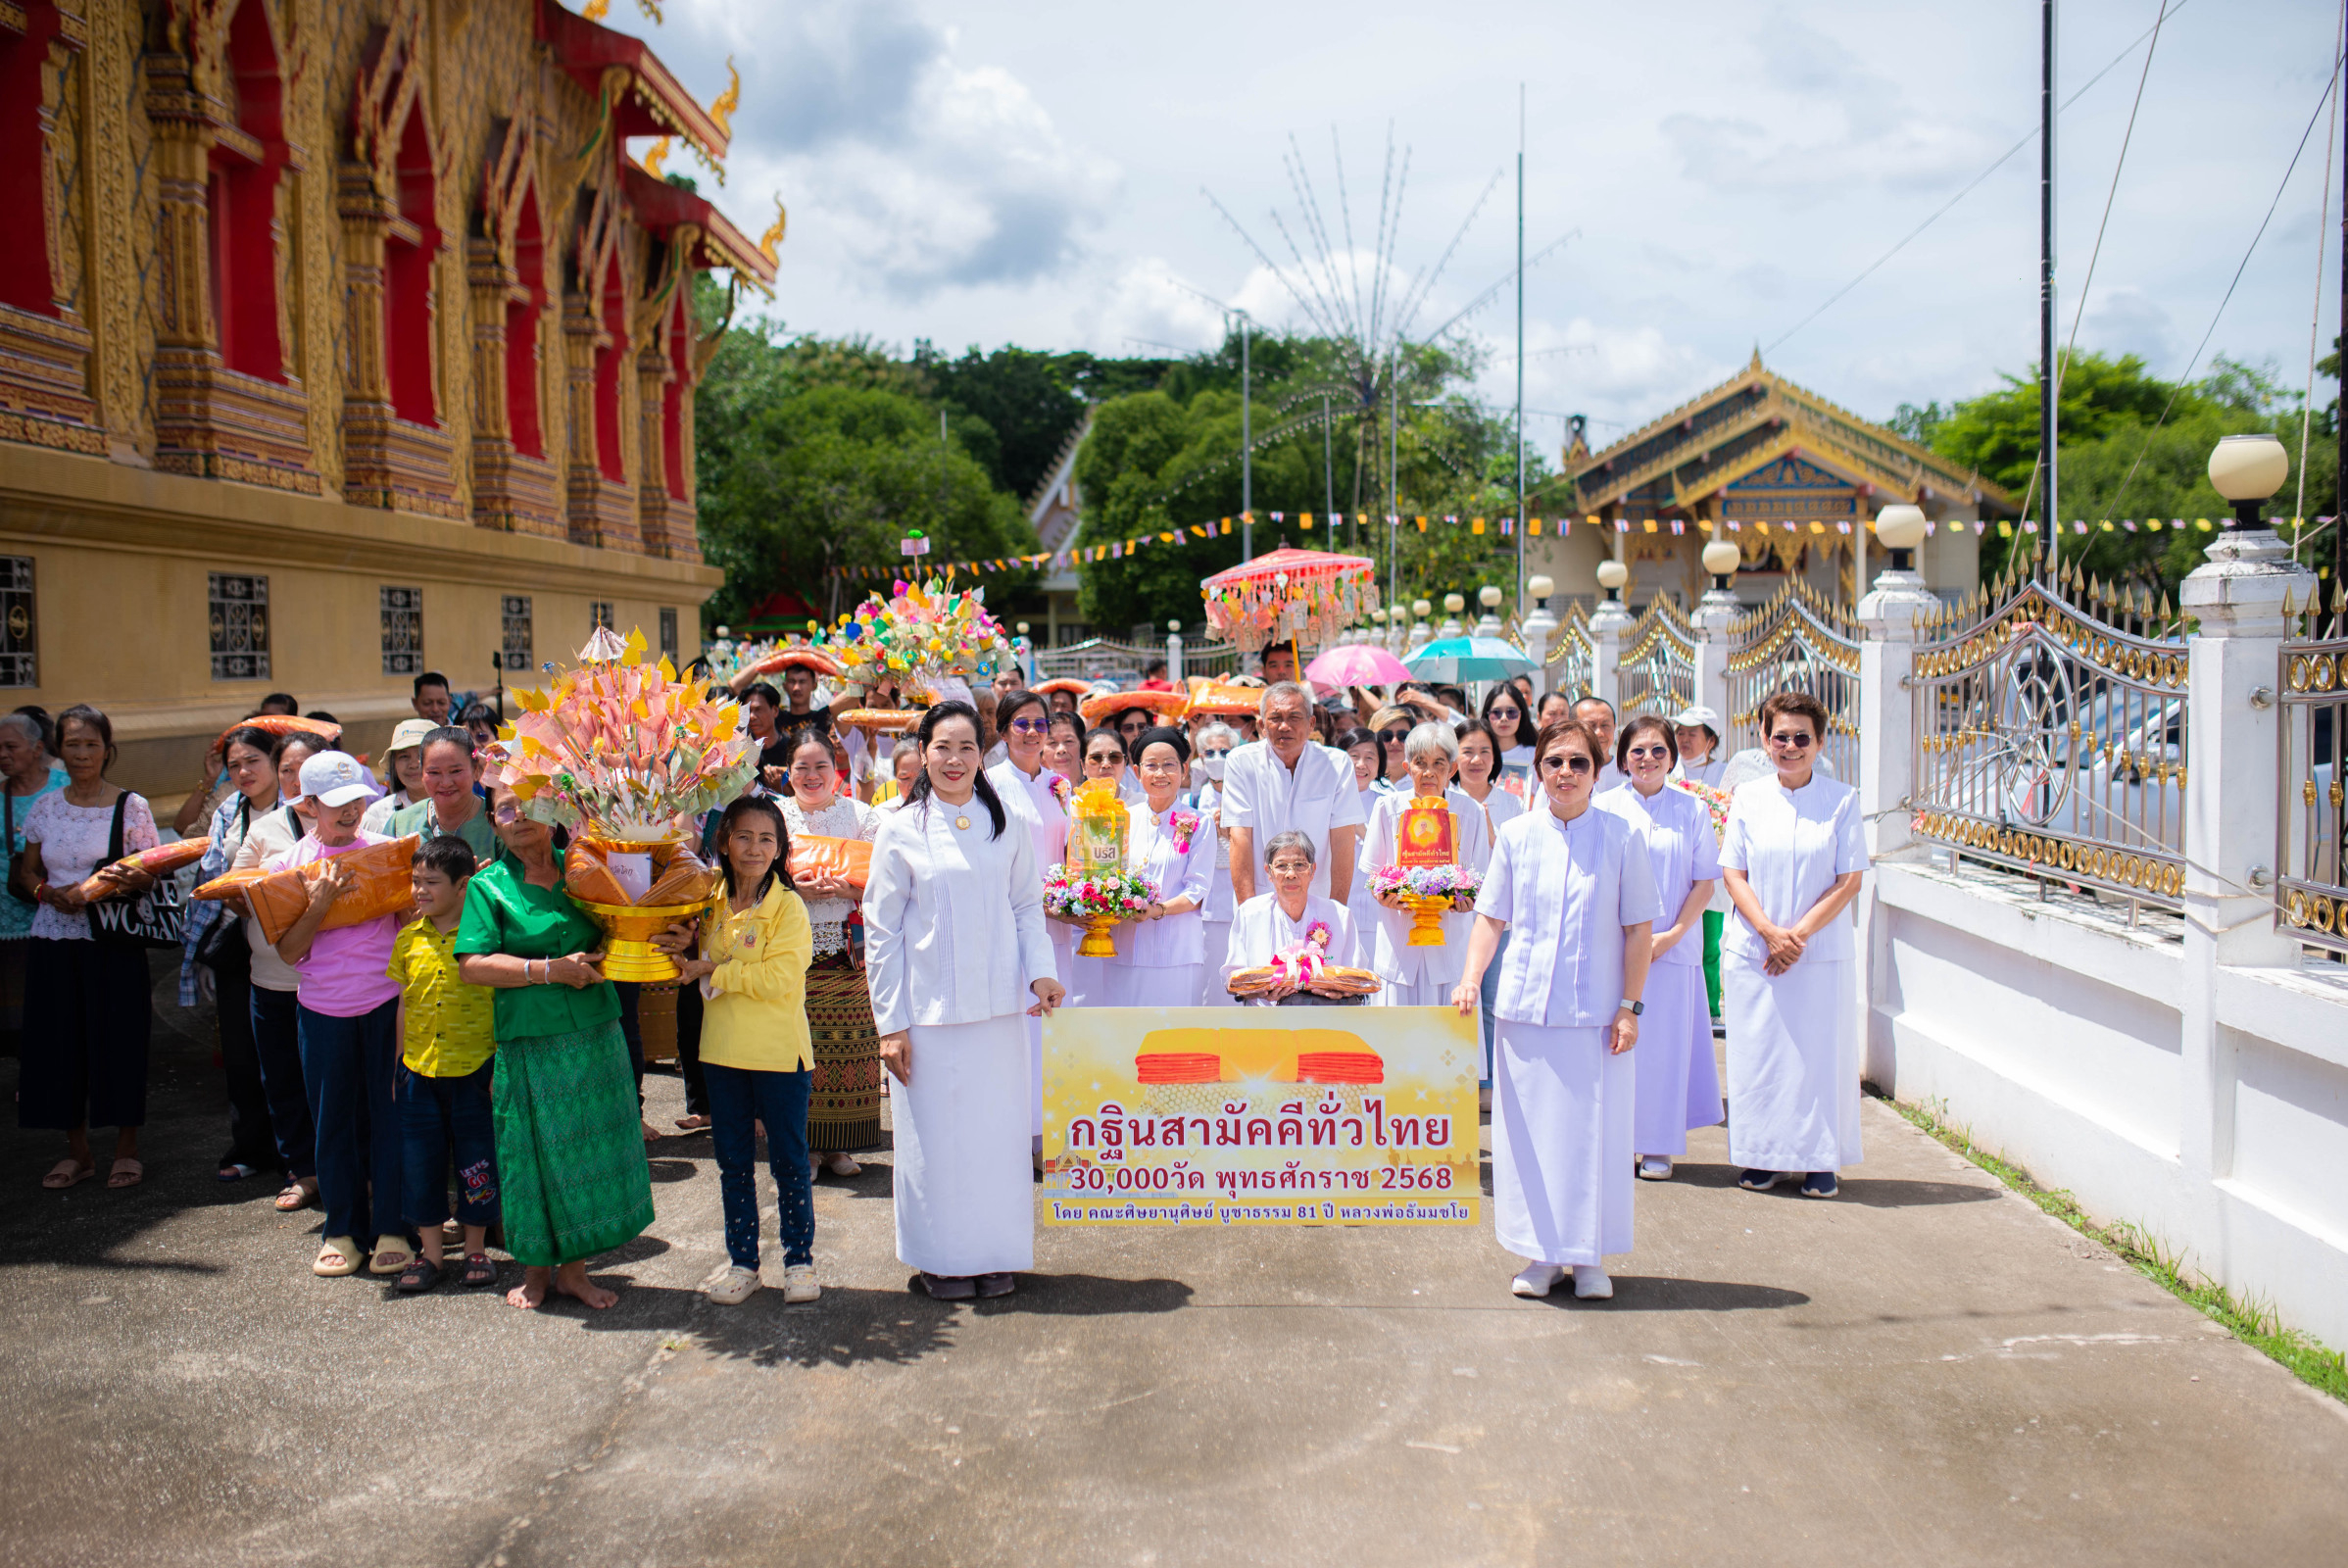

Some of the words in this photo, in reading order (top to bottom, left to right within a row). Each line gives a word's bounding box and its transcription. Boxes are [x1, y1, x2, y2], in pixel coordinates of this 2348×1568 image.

[1071, 1091, 1448, 1160] กฐินสามัคคีทั่วไทย
[467, 1172, 489, 1189] GO
[1071, 1161, 1204, 1195] 30,000วัด
[1215, 1160, 1370, 1199] พุทธศักราช
[1381, 1167, 1452, 1190] 2568
[1053, 1203, 1082, 1219] โดย
[1089, 1201, 1213, 1223] คณะศิษยานุศิษย์
[1220, 1206, 1291, 1224] บูชาธรรม
[1297, 1205, 1317, 1218] 81
[1323, 1202, 1334, 1218] ปี
[1340, 1201, 1469, 1219] หลวงพ่อธัมมชโย
